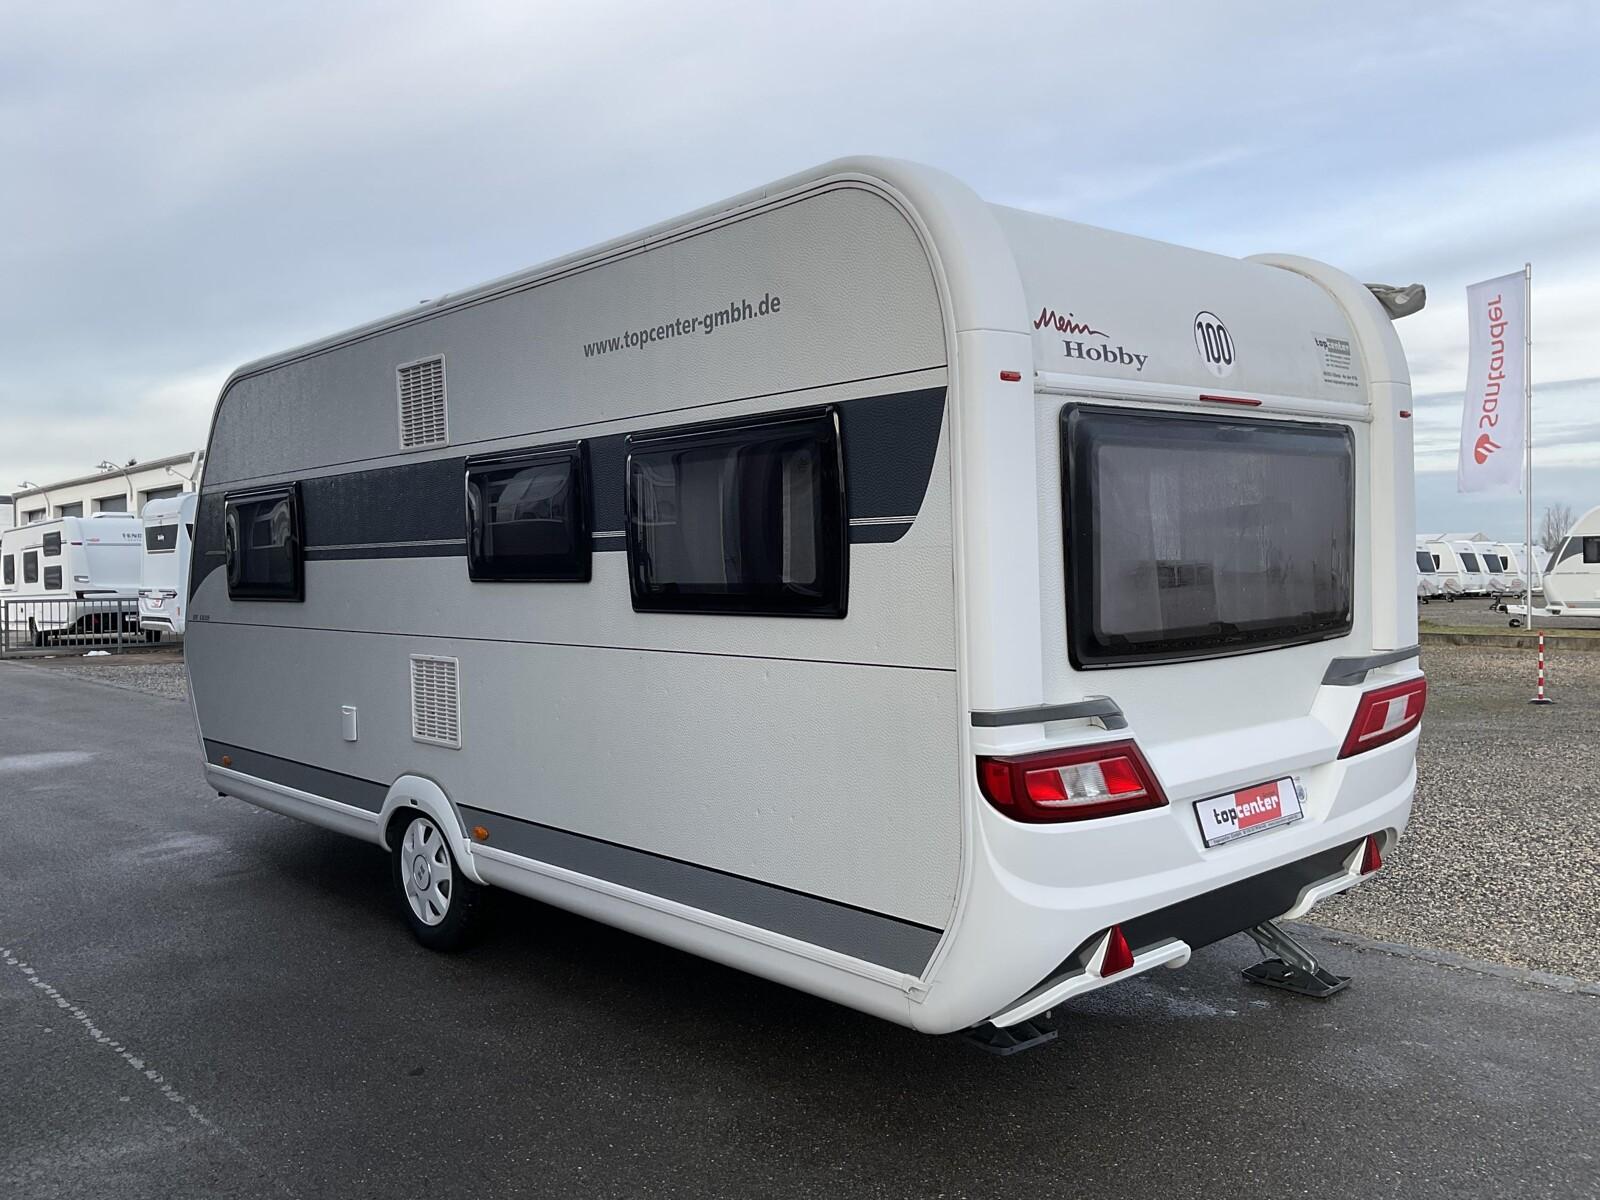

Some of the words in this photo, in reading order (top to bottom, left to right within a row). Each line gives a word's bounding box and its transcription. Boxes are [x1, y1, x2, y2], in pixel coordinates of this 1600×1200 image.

[583, 293, 781, 357] www.topcenter-gmbh.de
[1034, 307, 1110, 338] Mein
[1063, 339, 1149, 371] Hobby
[1197, 321, 1232, 365] 100
[1213, 795, 1279, 825] topcenter
